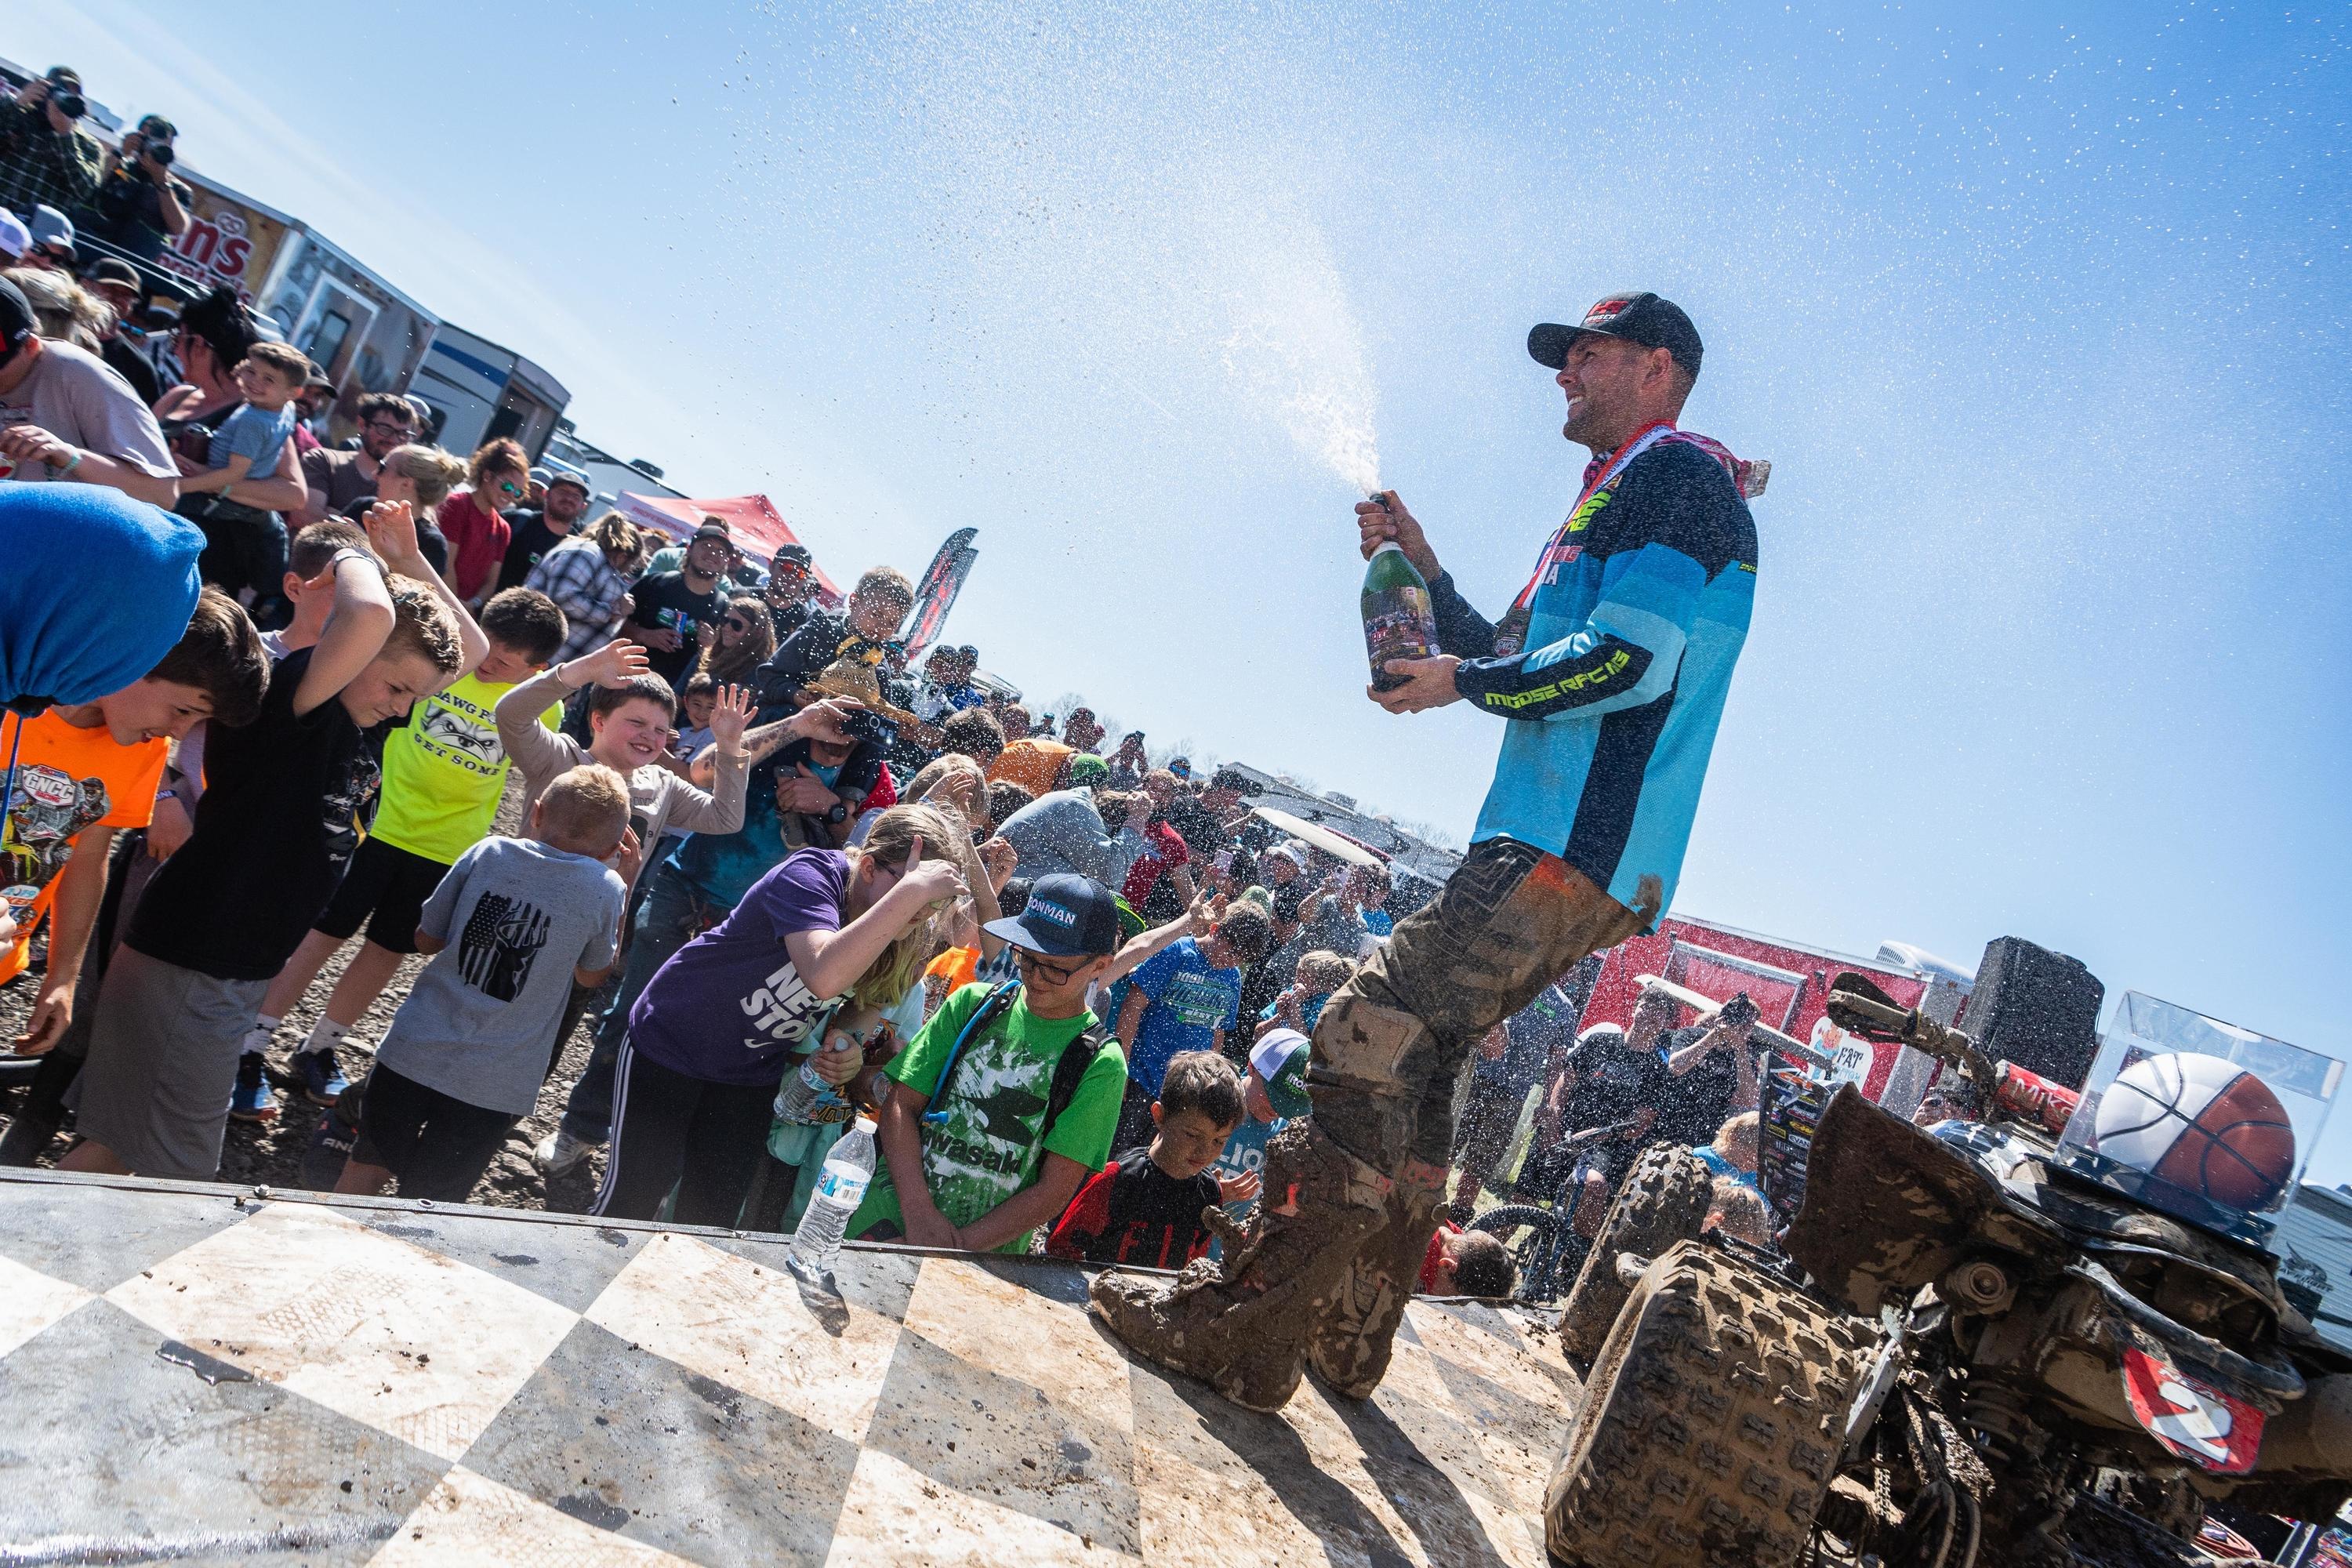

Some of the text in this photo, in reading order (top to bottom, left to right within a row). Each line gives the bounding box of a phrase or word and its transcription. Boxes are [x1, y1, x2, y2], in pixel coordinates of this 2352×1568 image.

[414, 733, 500, 776] GET SOME
[1836, 1047, 1864, 1069] FAT
